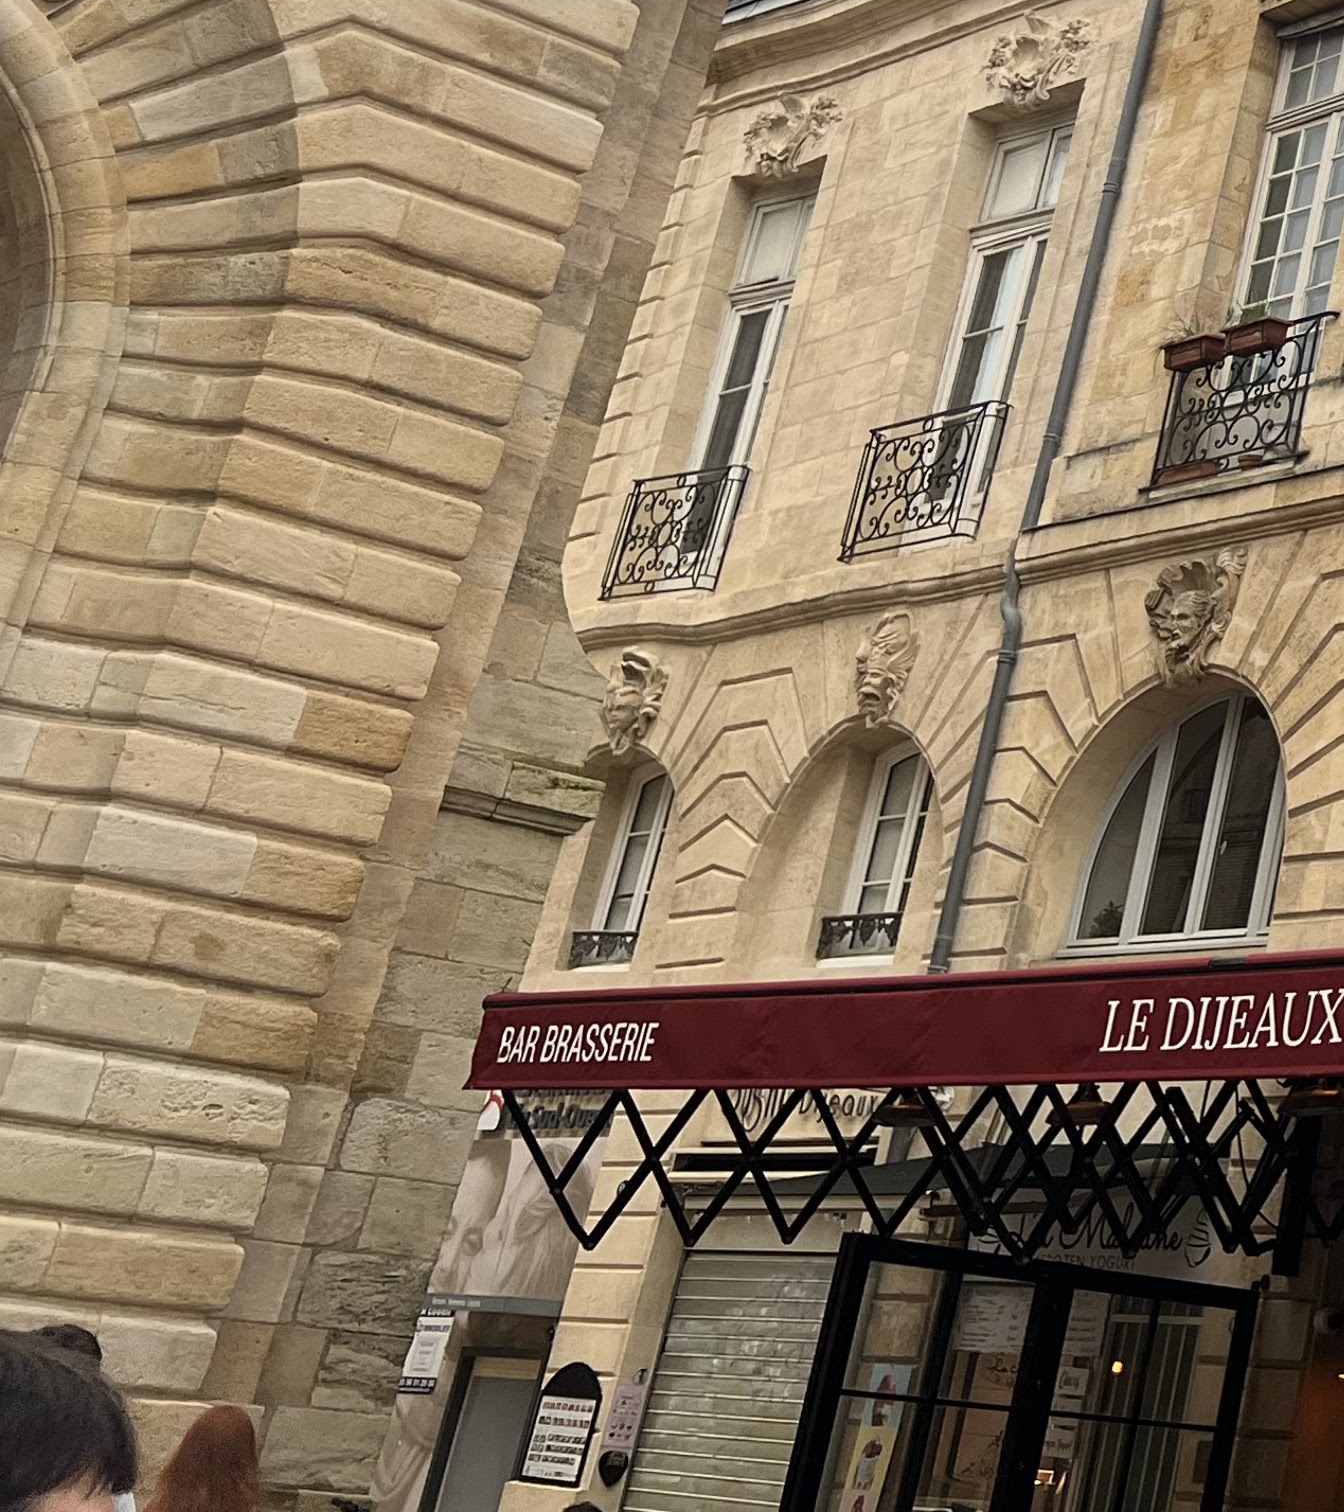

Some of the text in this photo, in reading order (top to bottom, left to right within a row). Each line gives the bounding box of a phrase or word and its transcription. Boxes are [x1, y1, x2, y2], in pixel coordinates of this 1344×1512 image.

[497, 1022, 660, 1063] BAR BRASSERIE
[1099, 999, 1154, 1052] LE
